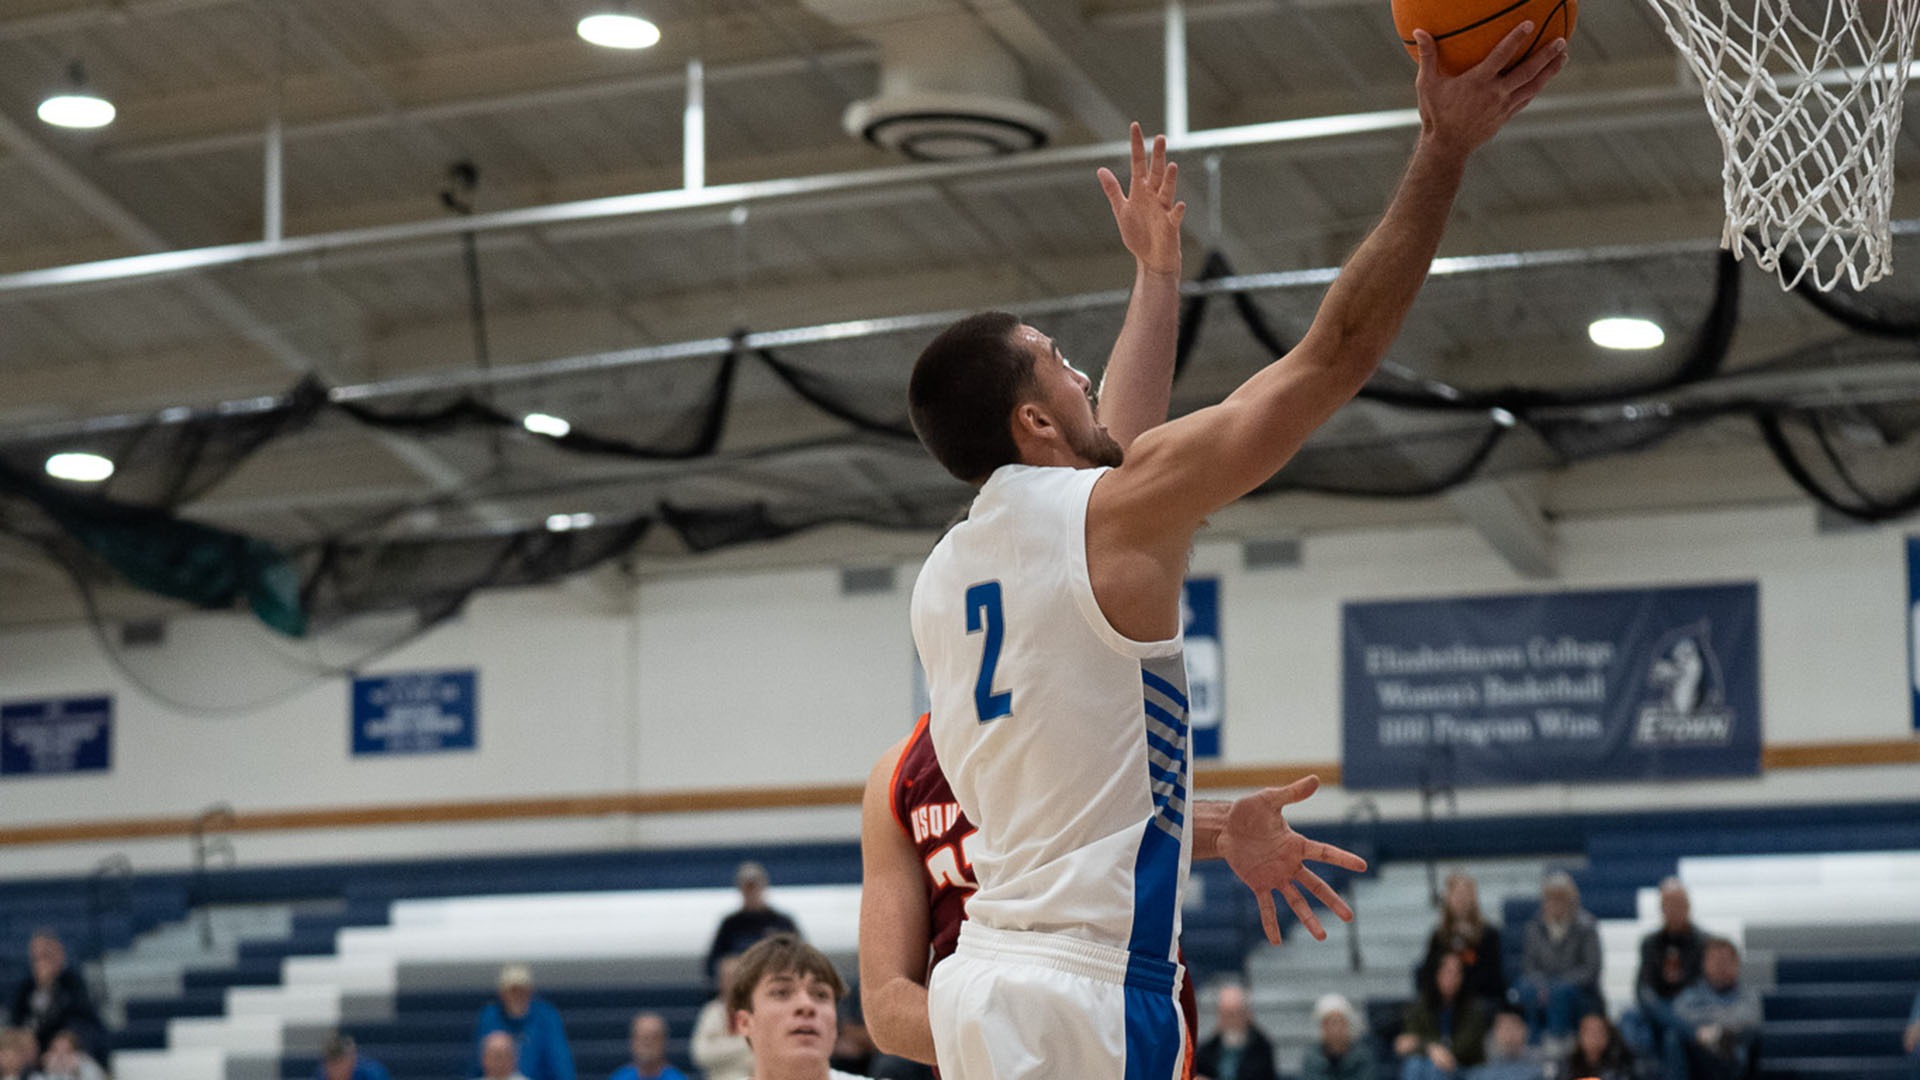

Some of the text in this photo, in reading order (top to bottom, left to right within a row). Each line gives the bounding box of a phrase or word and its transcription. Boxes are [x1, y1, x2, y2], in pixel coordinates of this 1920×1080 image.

[965, 580, 1014, 725] 2
[1527, 635, 1614, 668] College
[1483, 674, 1605, 706] Basketball
[1431, 713, 1533, 747] Program
[1535, 708, 1602, 738] Wins
